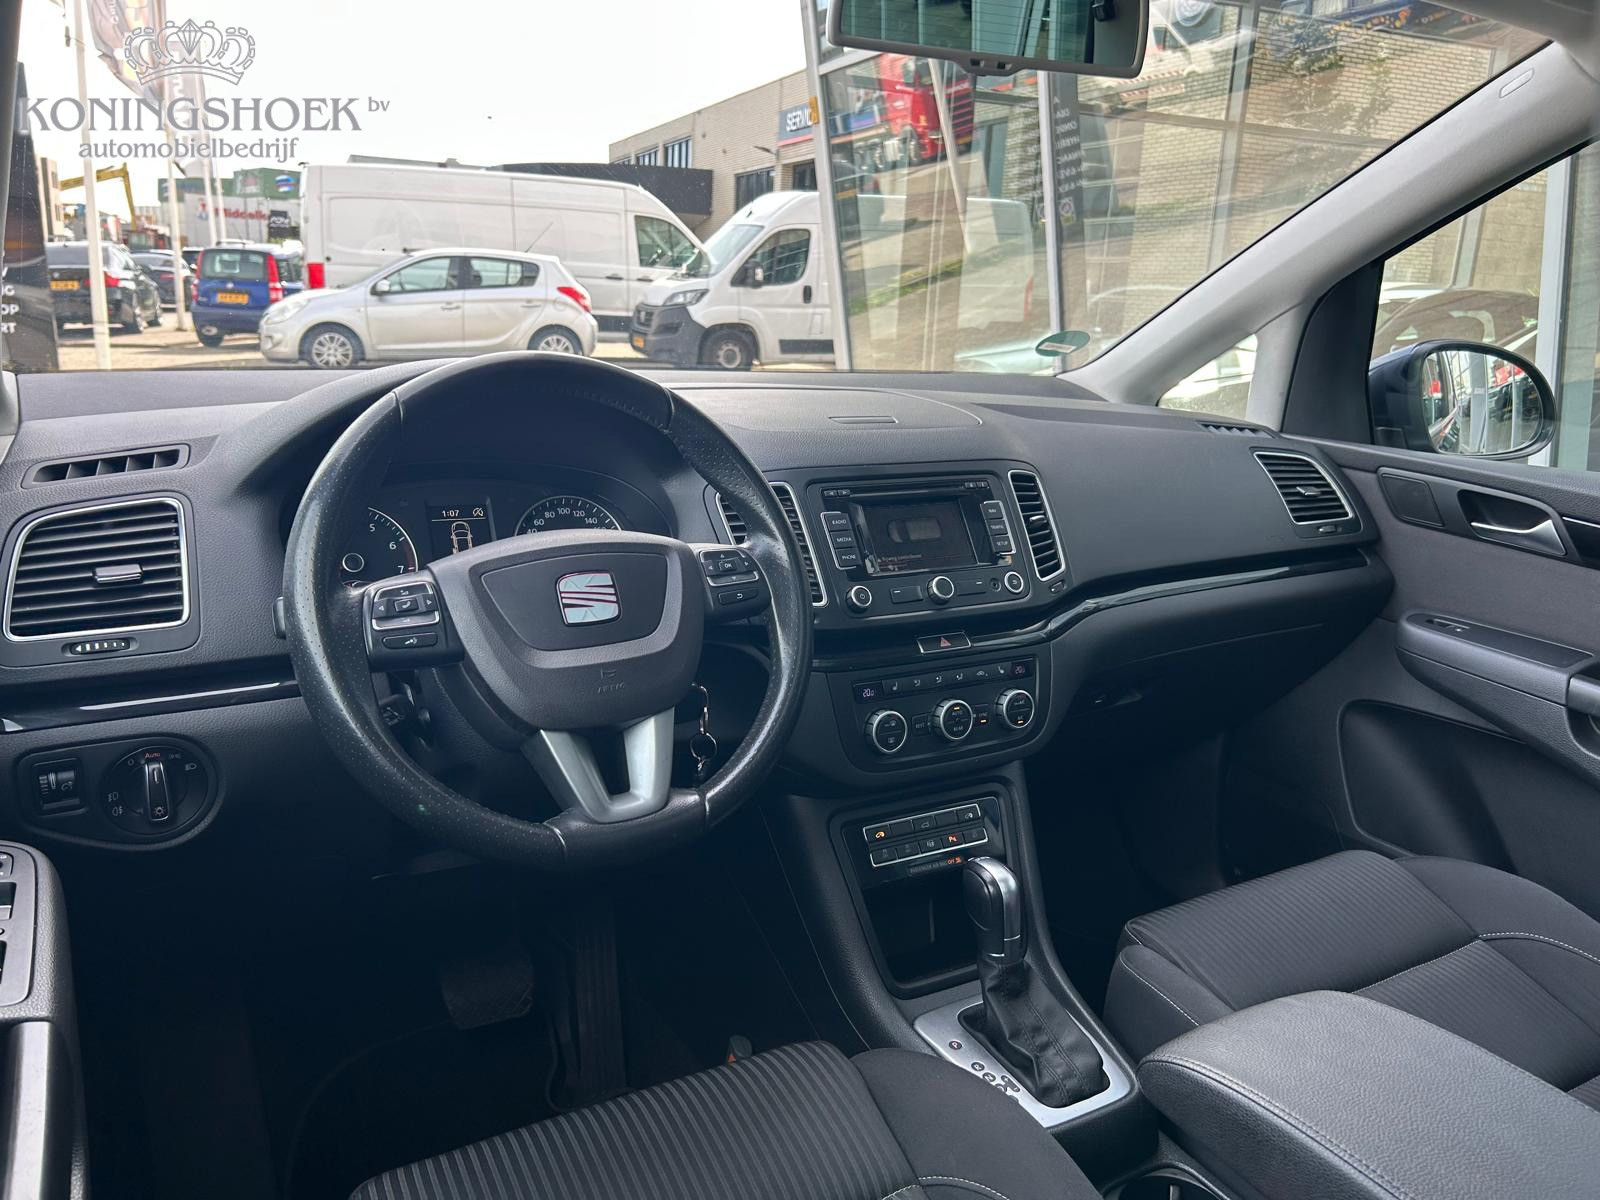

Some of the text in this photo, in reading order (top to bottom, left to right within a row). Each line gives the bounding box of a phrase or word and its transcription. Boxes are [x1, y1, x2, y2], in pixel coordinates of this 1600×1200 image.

[441, 509, 460, 518] 1:07
[544, 511, 556, 519] 80
[557, 507, 571, 515] 100
[572, 510, 586, 518] 120
[533, 518, 545, 526] 60
[585, 517, 598, 525] 140
[369, 523, 376, 532] 5
[389, 541, 397, 550] 6
[397, 565, 405, 574] 7
